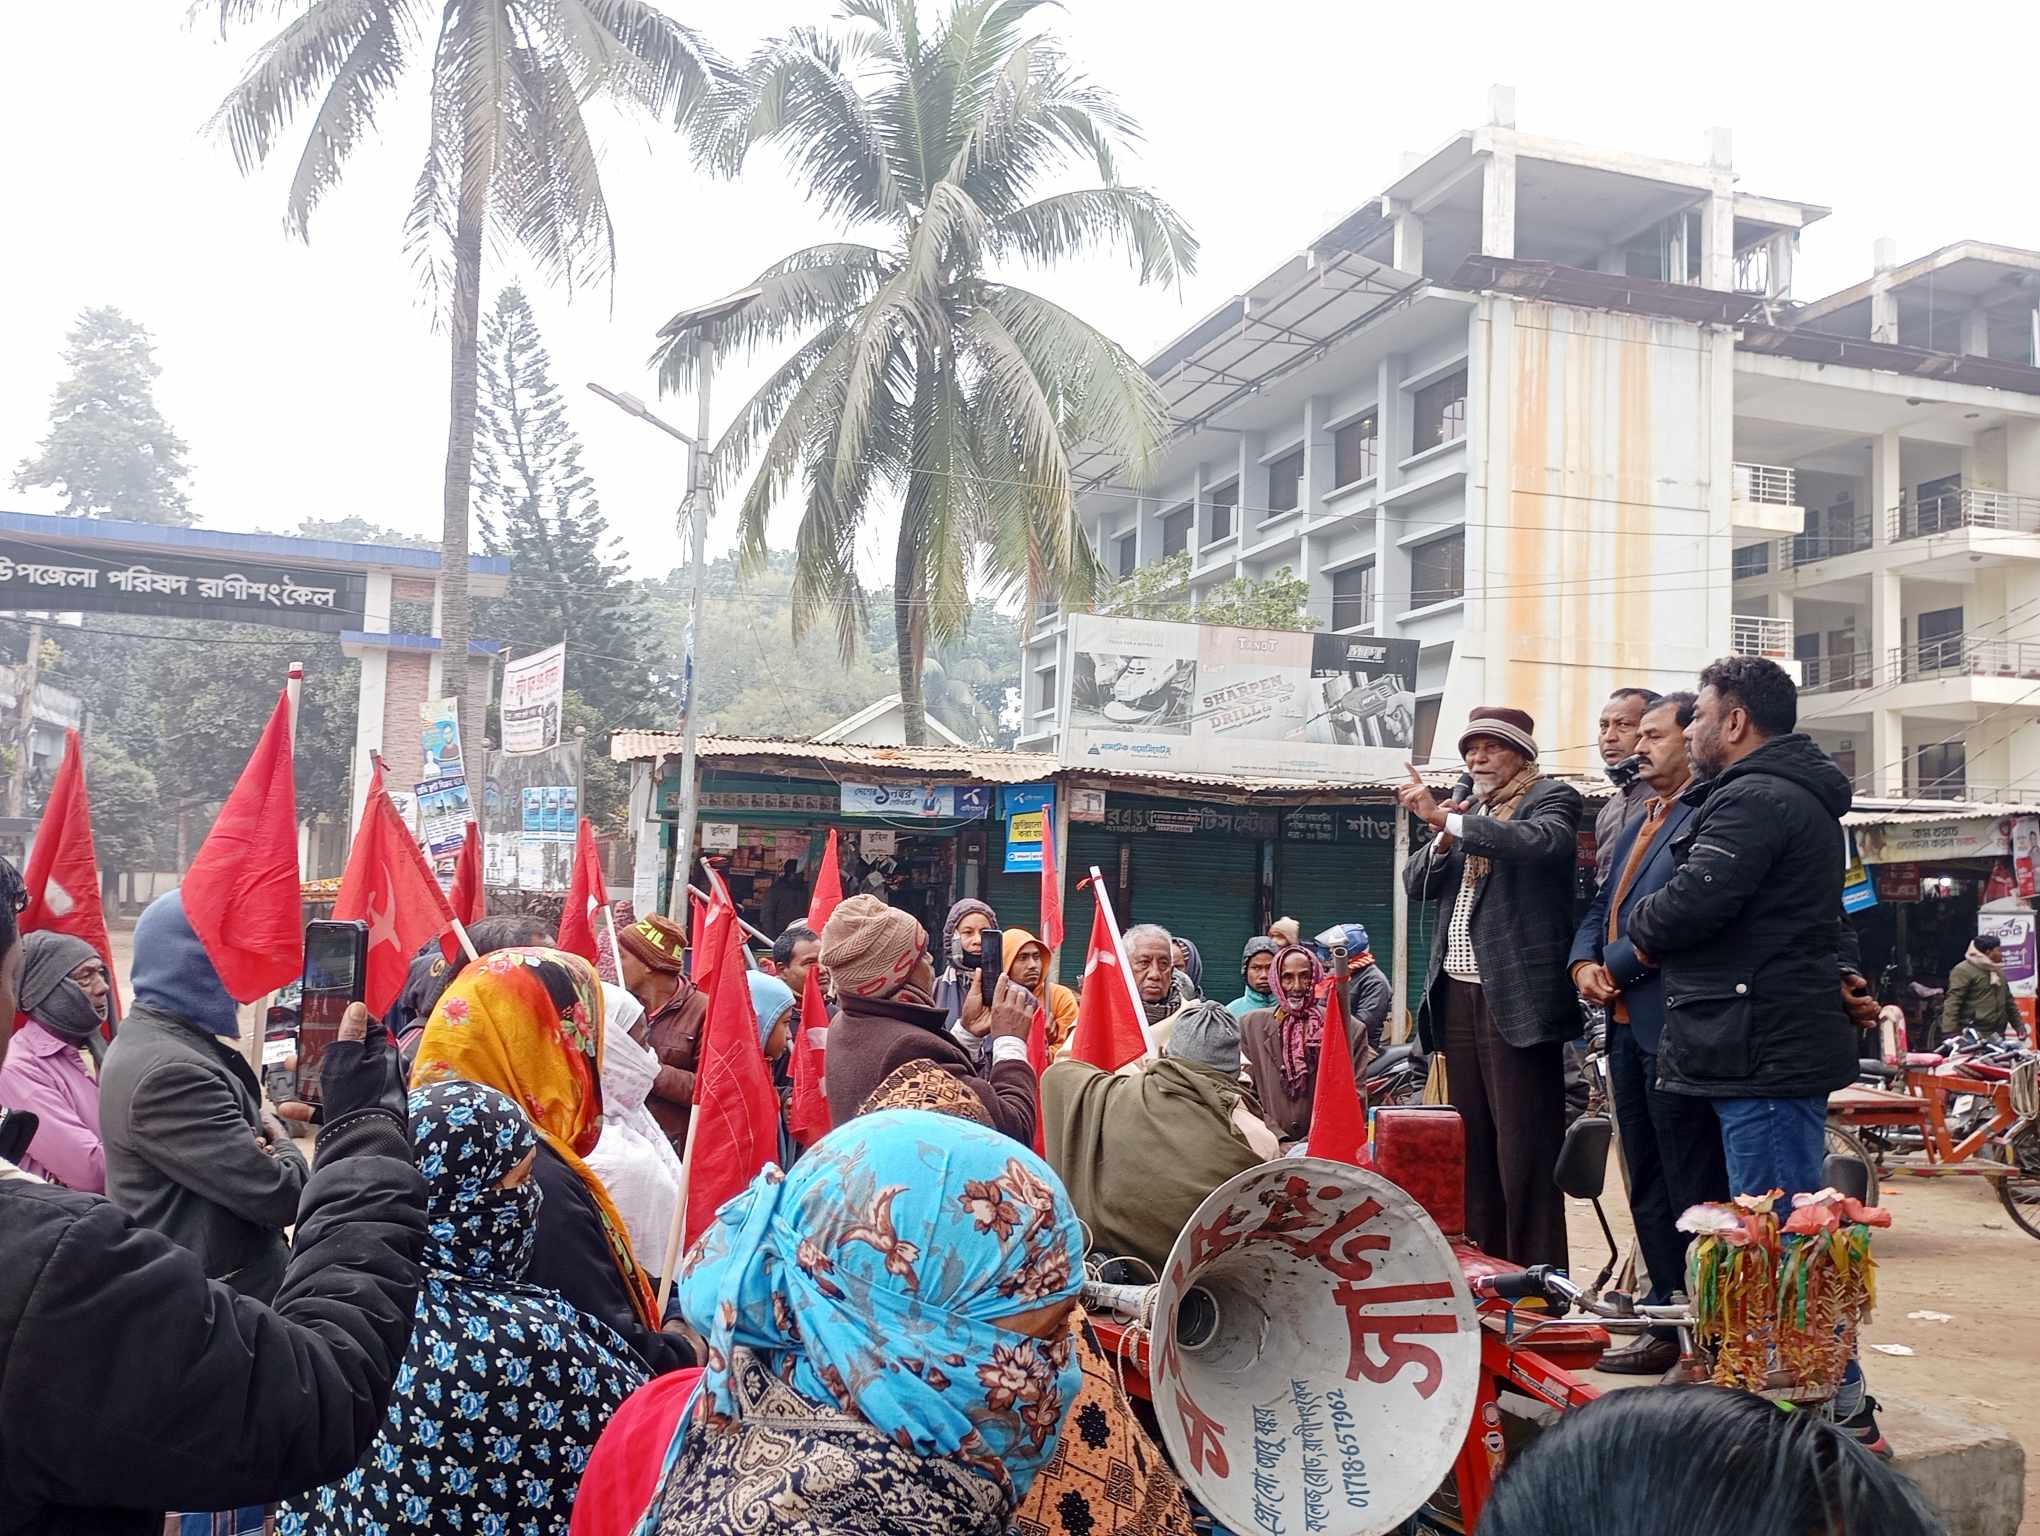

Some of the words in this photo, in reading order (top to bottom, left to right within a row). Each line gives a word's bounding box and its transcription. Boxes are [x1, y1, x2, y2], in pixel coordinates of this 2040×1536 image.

[107, 565, 189, 597] পরিষদ
[197, 572, 337, 608] রাণীশংকৈল
[1202, 673, 1283, 709] SHARPEN
[1208, 704, 1262, 729] DRILL
[1252, 1436, 1286, 1469] আবু
[1304, 1485, 1333, 1532] কলেজ
